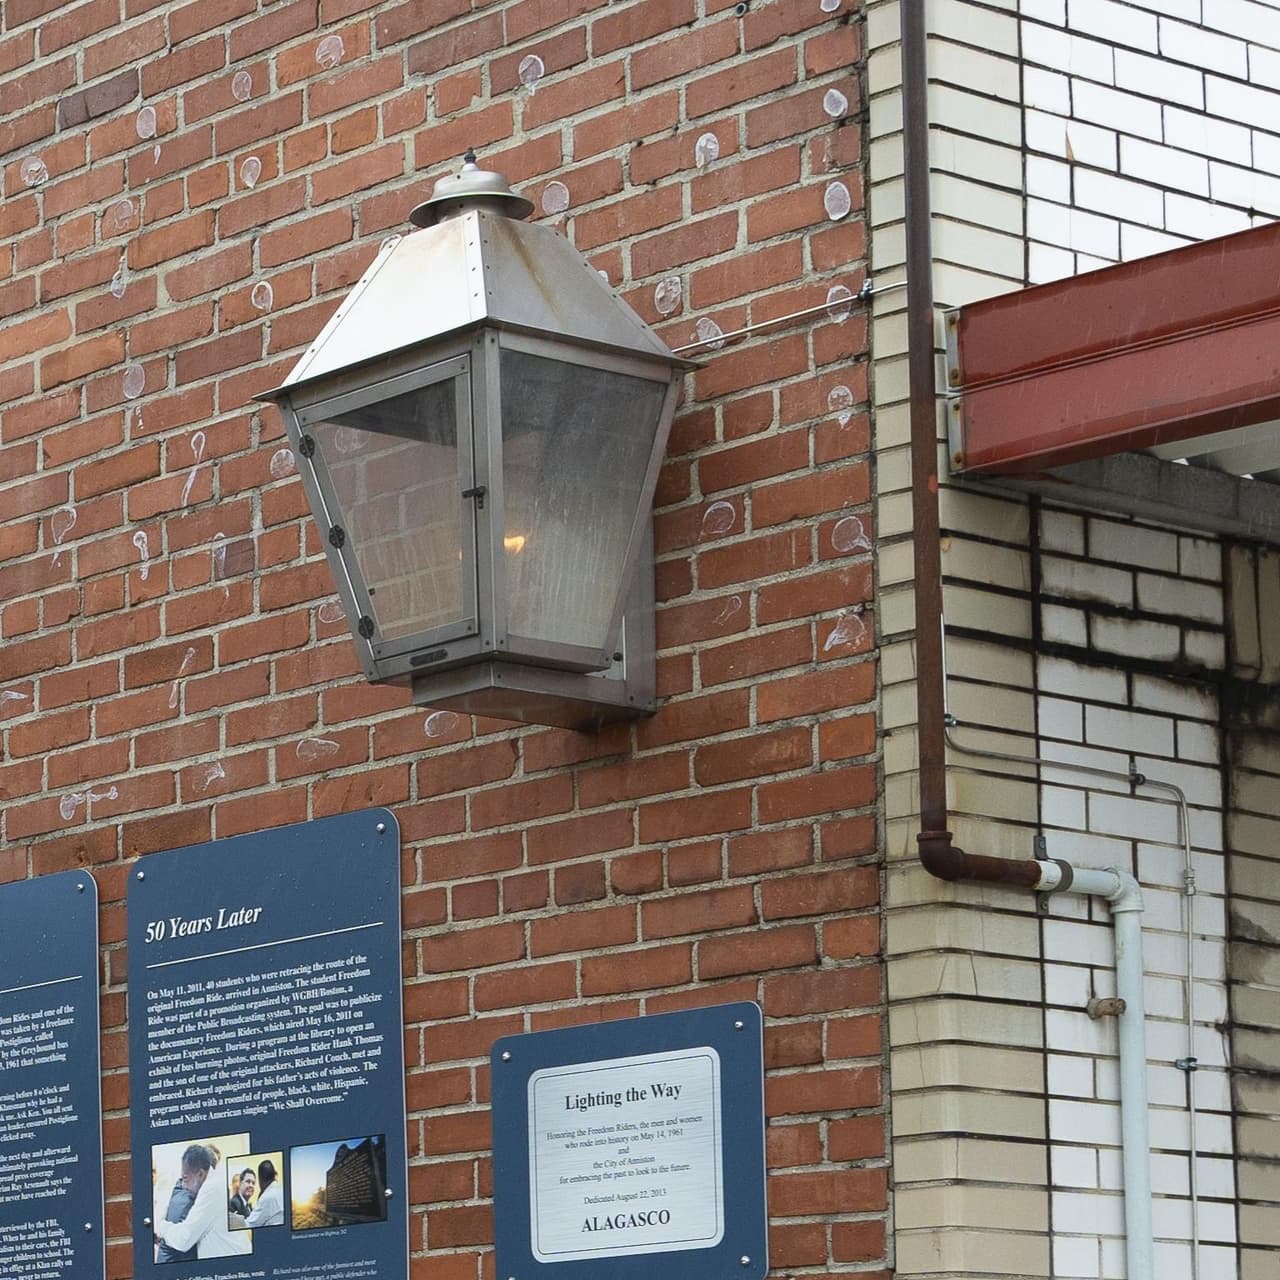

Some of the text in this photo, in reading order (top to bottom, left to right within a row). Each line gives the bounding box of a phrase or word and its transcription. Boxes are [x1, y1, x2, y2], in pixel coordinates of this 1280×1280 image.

[145, 907, 262, 942] 50 Years Later
[147, 991, 158, 1000] On
[159, 988, 174, 998] May
[176, 986, 186, 995] 11,
[187, 983, 205, 993] 2011,
[205, 981, 214, 989] 40
[215, 977, 244, 988] students
[245, 973, 260, 982] who
[279, 965, 311, 977] retracing
[312, 962, 324, 971] the
[325, 960, 345, 969] route
[346, 955, 354, 965] of
[355, 955, 367, 964] the
[147, 969, 370, 1013] original Freedom Ride, arrived in Anniston. The student Freedom
[566, 1083, 682, 1112] Lighting the Way
[546, 1131, 575, 1140] Honoring
[587, 1126, 614, 1135] Freedom
[616, 1123, 638, 1131] Riders,
[639, 1121, 649, 1129] the
[665, 1116, 678, 1125] and
[617, 1146, 629, 1154] and
[584, 1188, 666, 1204] Dedicated August 22, 2013
[582, 1210, 670, 1232] ALAGASCO
